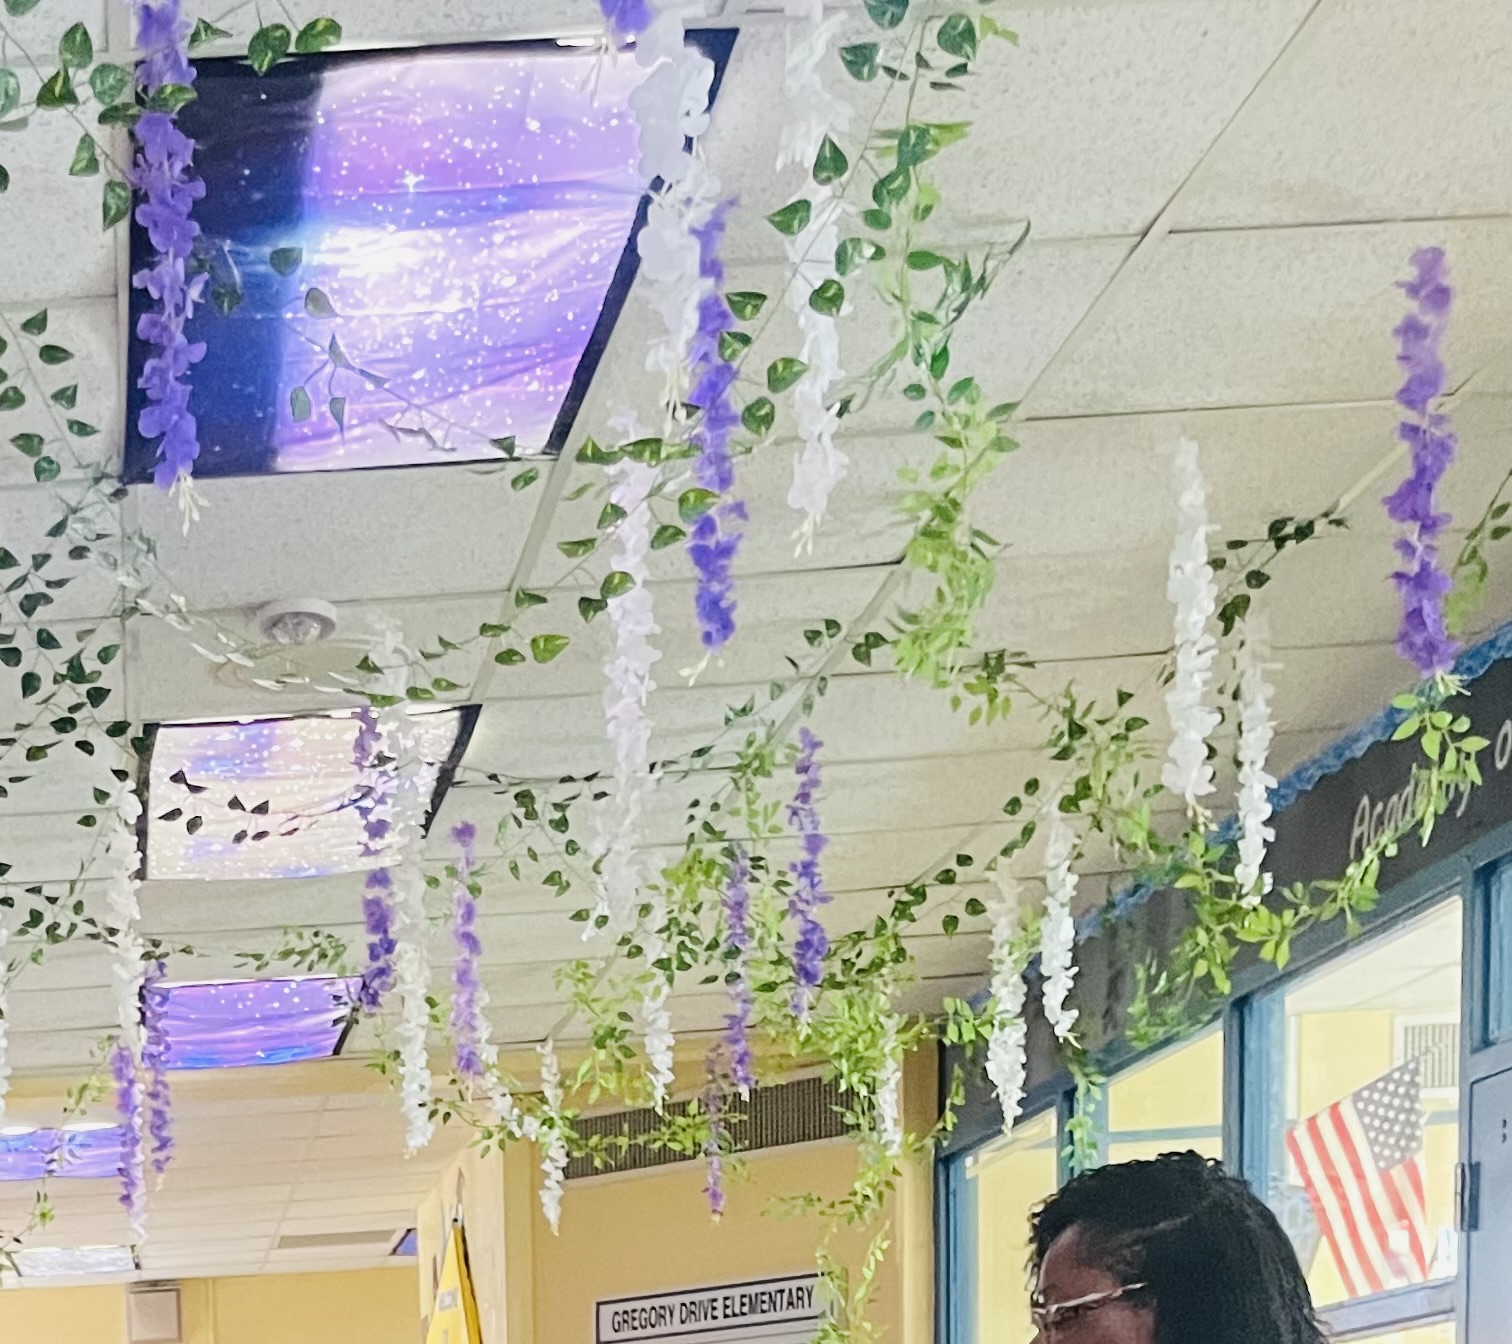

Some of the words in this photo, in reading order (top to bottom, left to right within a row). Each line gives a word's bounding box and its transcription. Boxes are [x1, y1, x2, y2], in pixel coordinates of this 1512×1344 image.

[612, 1304, 675, 1333] GREGORY
[680, 1300, 719, 1325] DRIVE
[723, 1285, 815, 1319] ELEMENTARY
